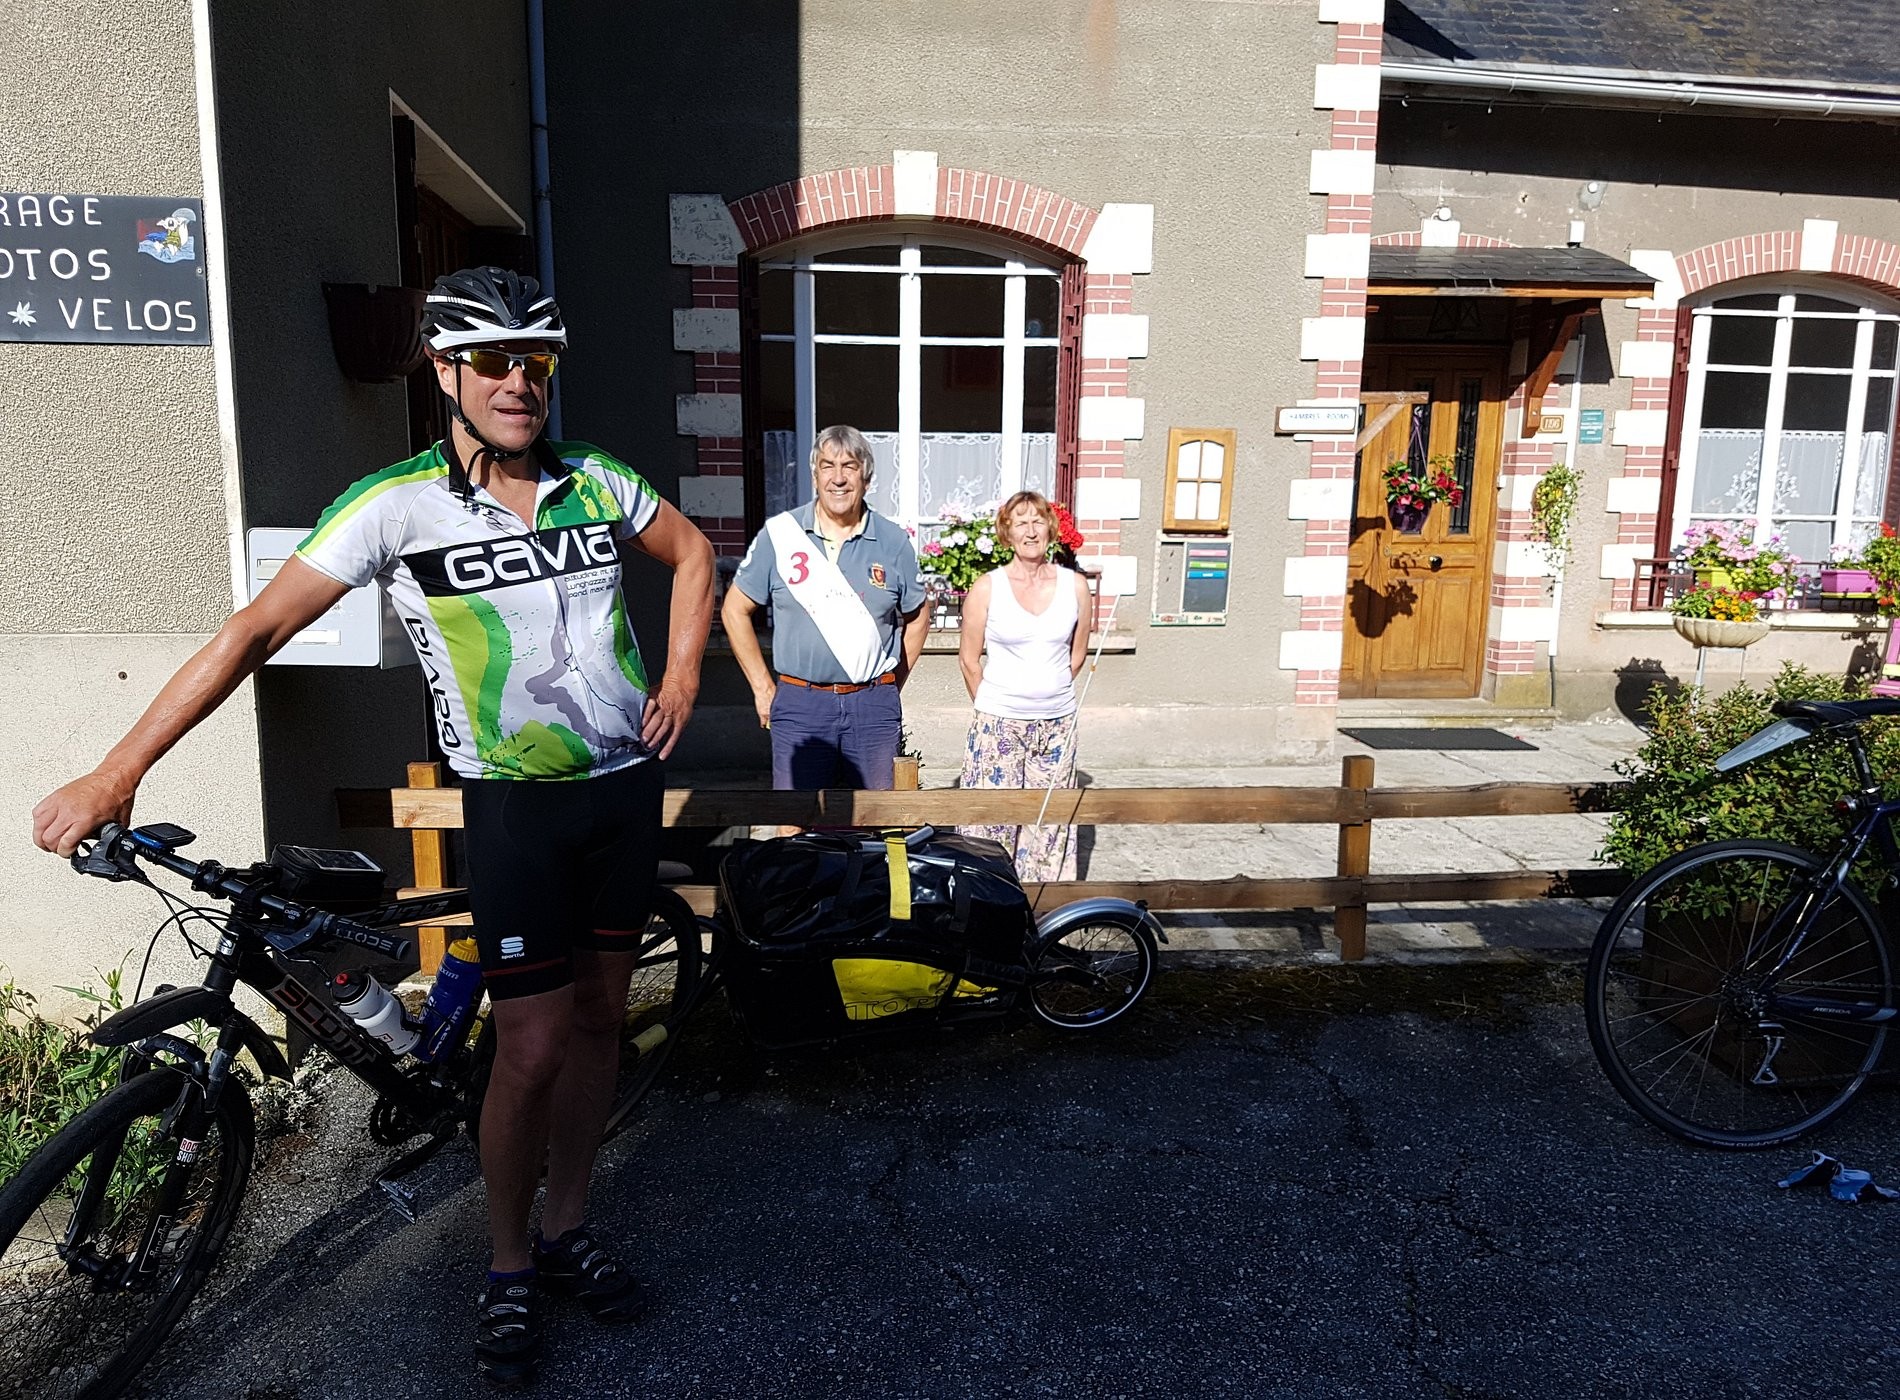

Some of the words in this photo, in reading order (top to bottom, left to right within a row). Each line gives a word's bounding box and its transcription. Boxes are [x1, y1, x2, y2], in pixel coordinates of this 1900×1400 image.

[58, 297, 197, 332] VELOS
[788, 551, 810, 585] 3
[335, 927, 394, 952] SCOTT
